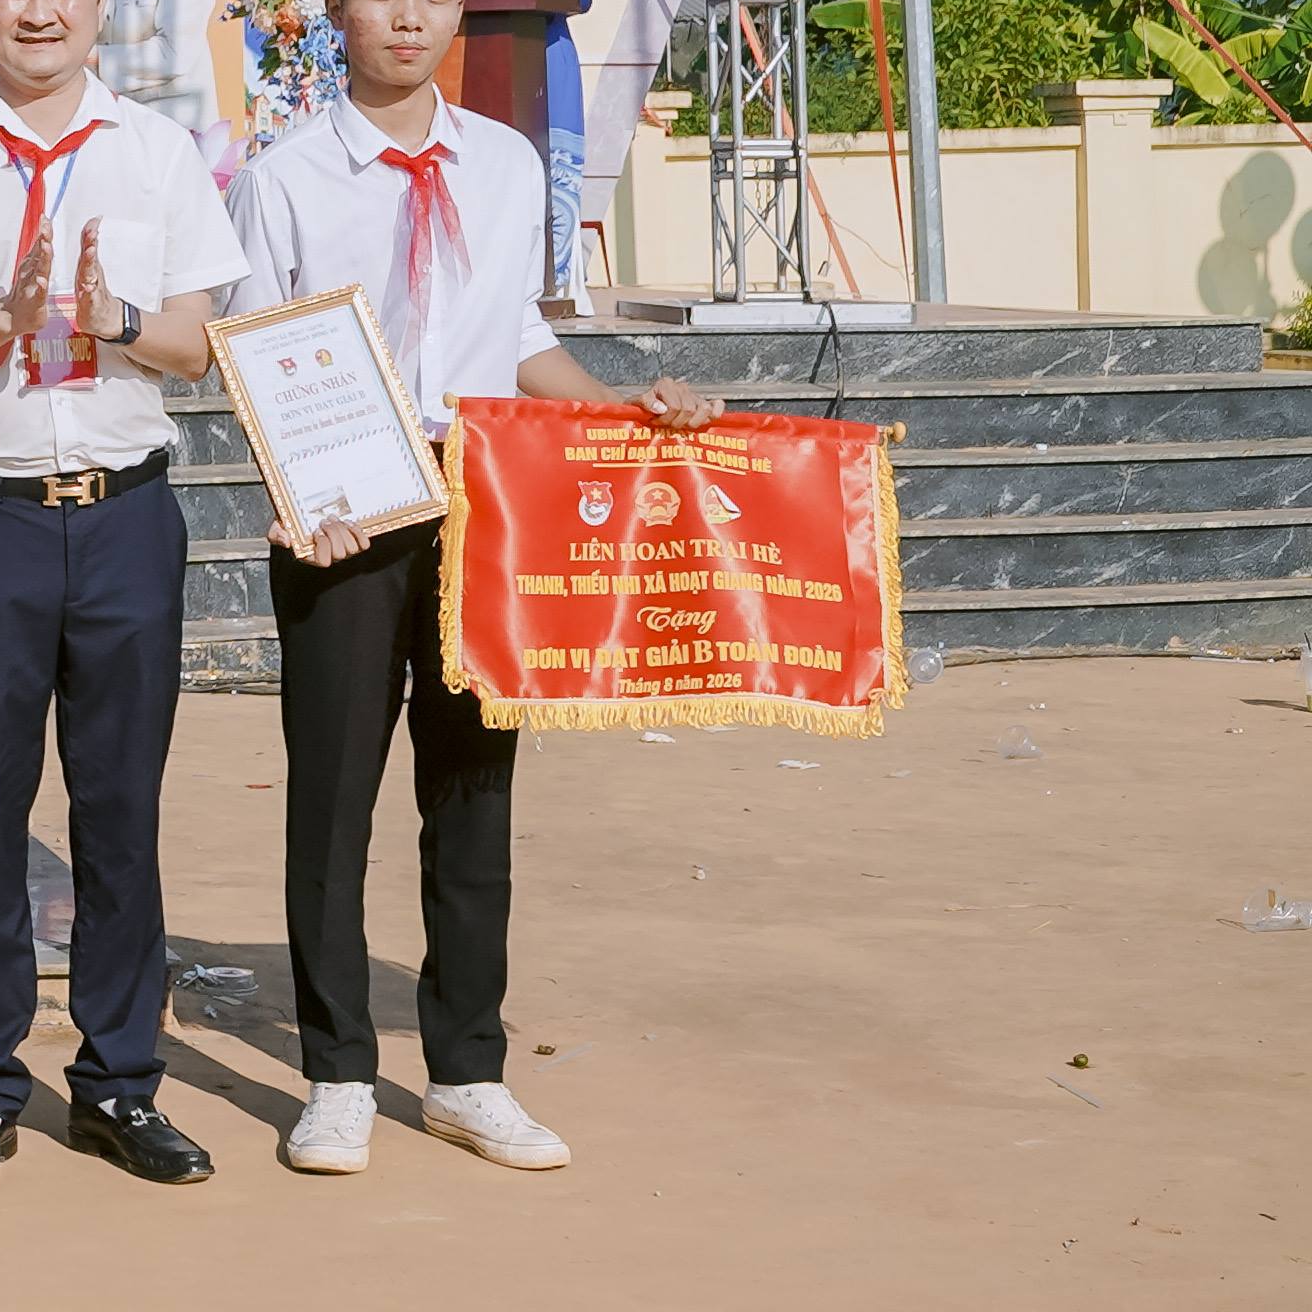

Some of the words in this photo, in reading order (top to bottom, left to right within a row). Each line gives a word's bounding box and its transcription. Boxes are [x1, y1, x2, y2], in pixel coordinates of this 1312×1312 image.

[569, 537, 614, 561] LIÊN
[619, 540, 685, 562] HOAN
[753, 542, 783, 565] HÈ
[637, 606, 717, 634] Tặng
[523, 646, 566, 670] ĐƠN
[570, 648, 590, 673] VỊ
[596, 646, 639, 671] ĐẠT
[646, 638, 689, 667] GIẢI
[694, 640, 713, 664] B
[716, 638, 779, 664] TOÀN
[783, 643, 842, 672] ĐOÀN
[618, 677, 661, 697] Tháng
[664, 678, 673, 692] 8
[675, 675, 703, 691] năm
[706, 673, 742, 689] 2026
